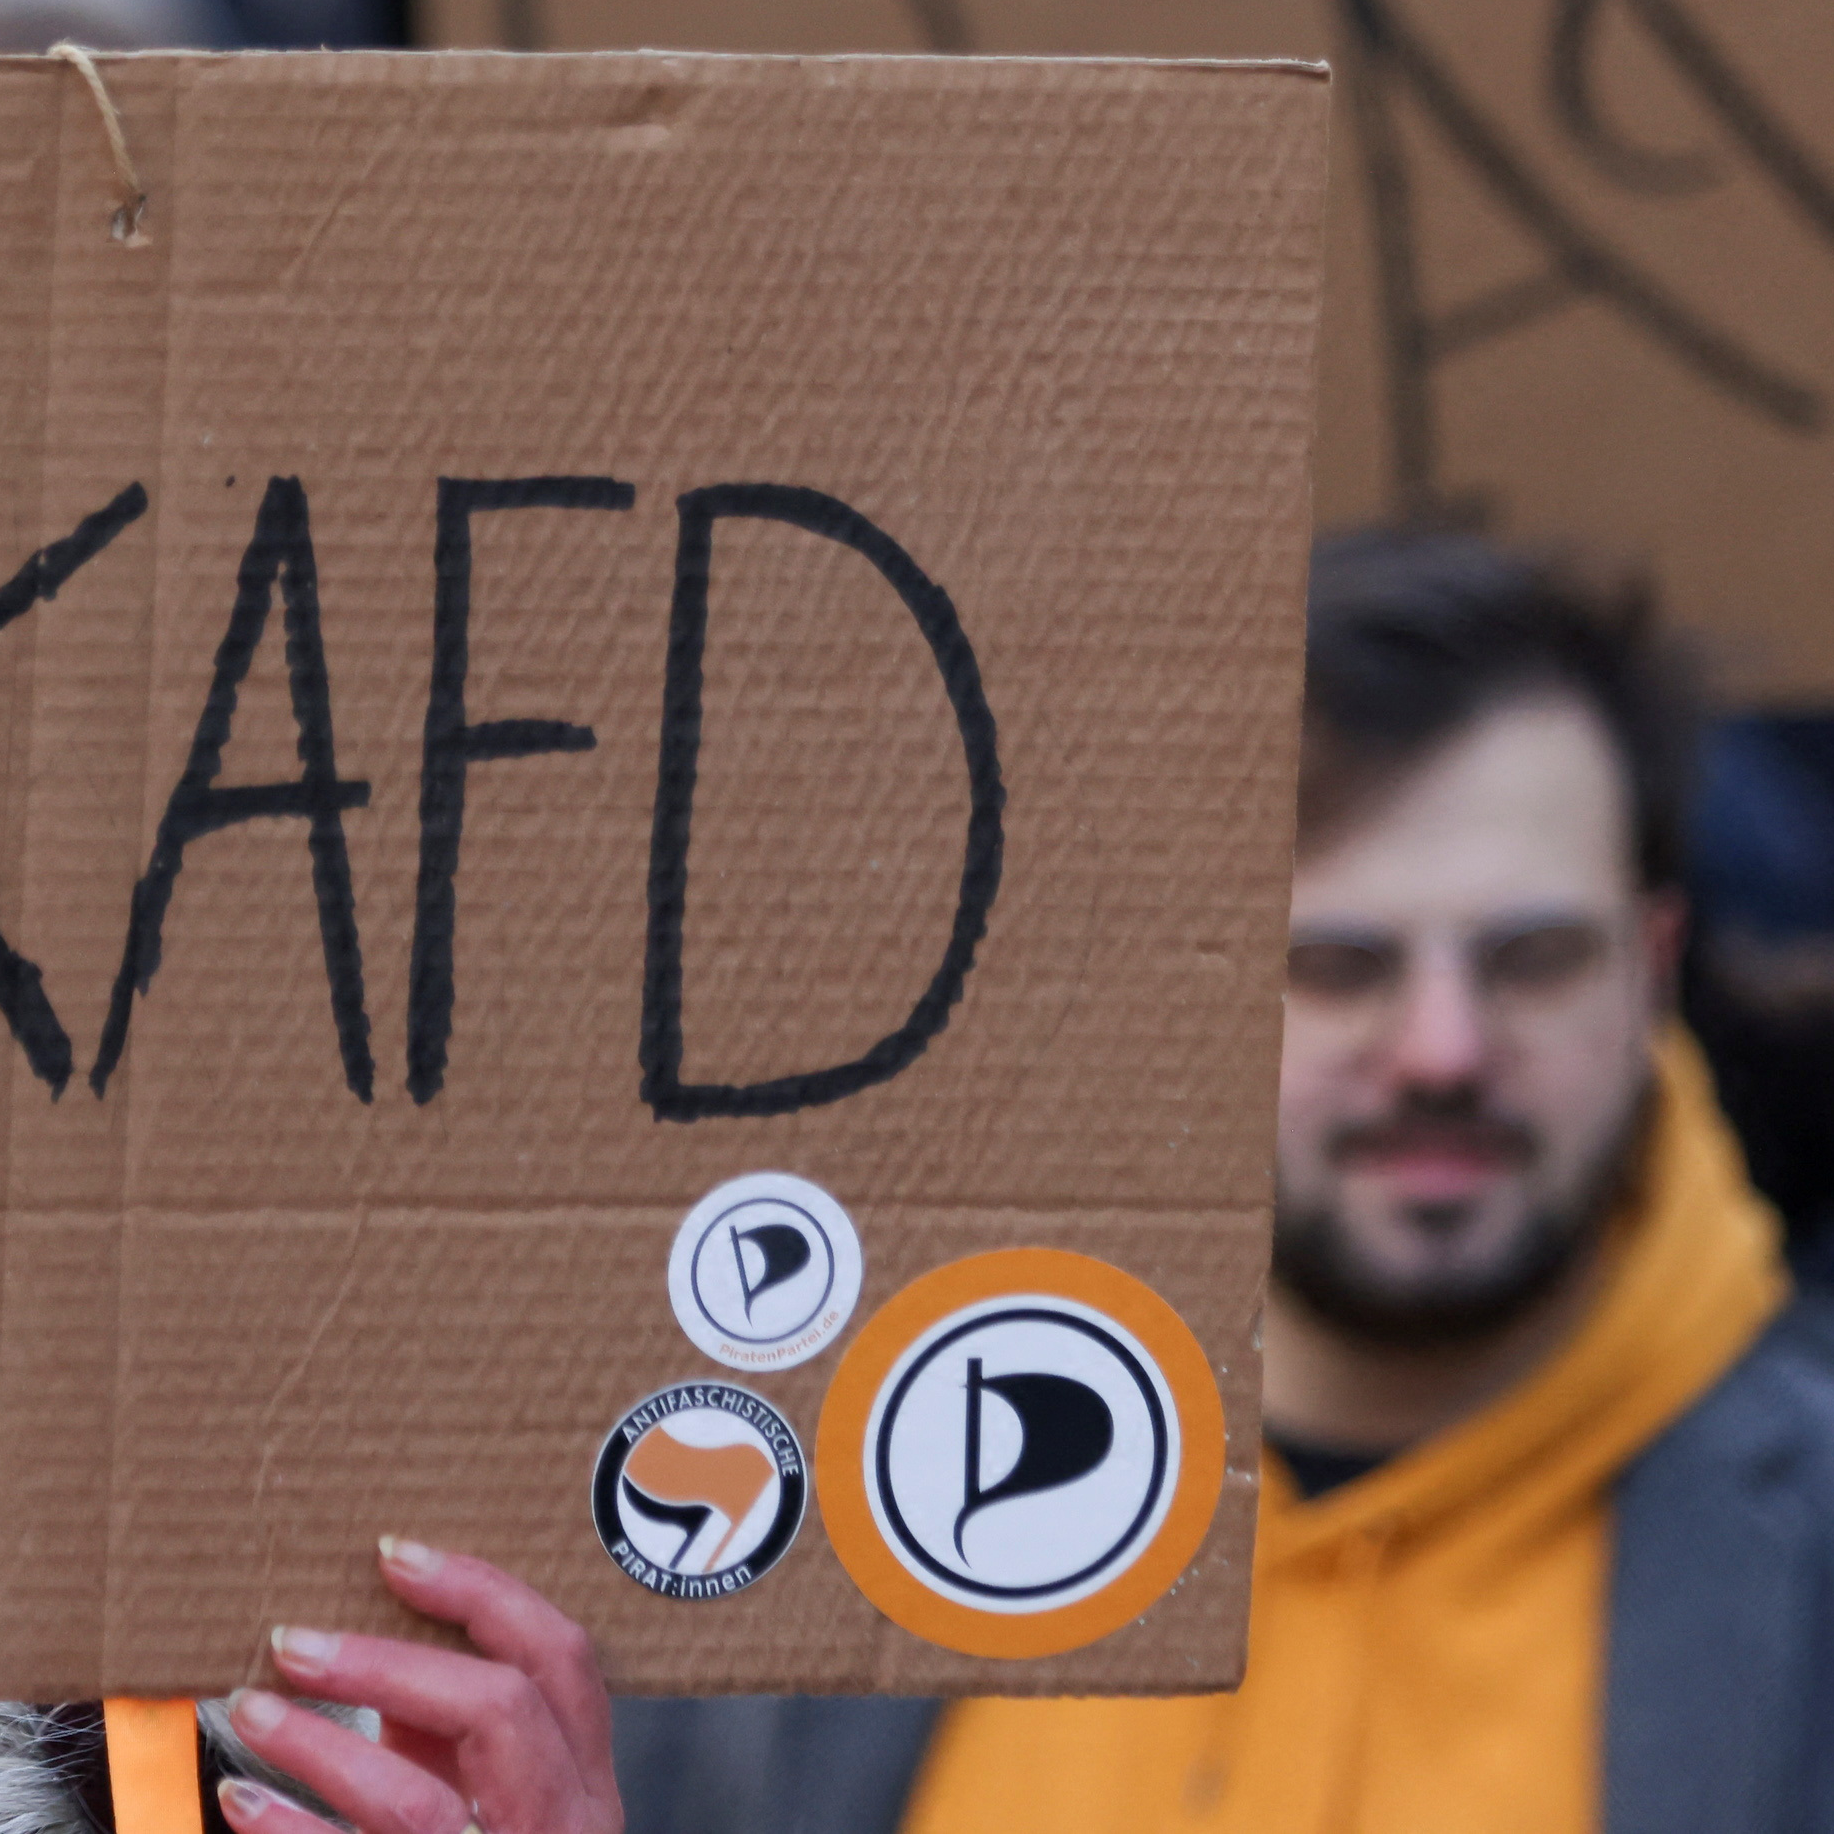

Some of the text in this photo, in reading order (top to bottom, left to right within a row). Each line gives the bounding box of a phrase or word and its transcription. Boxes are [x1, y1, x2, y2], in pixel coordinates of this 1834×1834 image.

[718, 1310, 840, 1364] PiratenPartei.de
[620, 1386, 801, 1478] ANTIFASCHISTISCHE
[610, 1538, 753, 1598] PIRAT:innen
